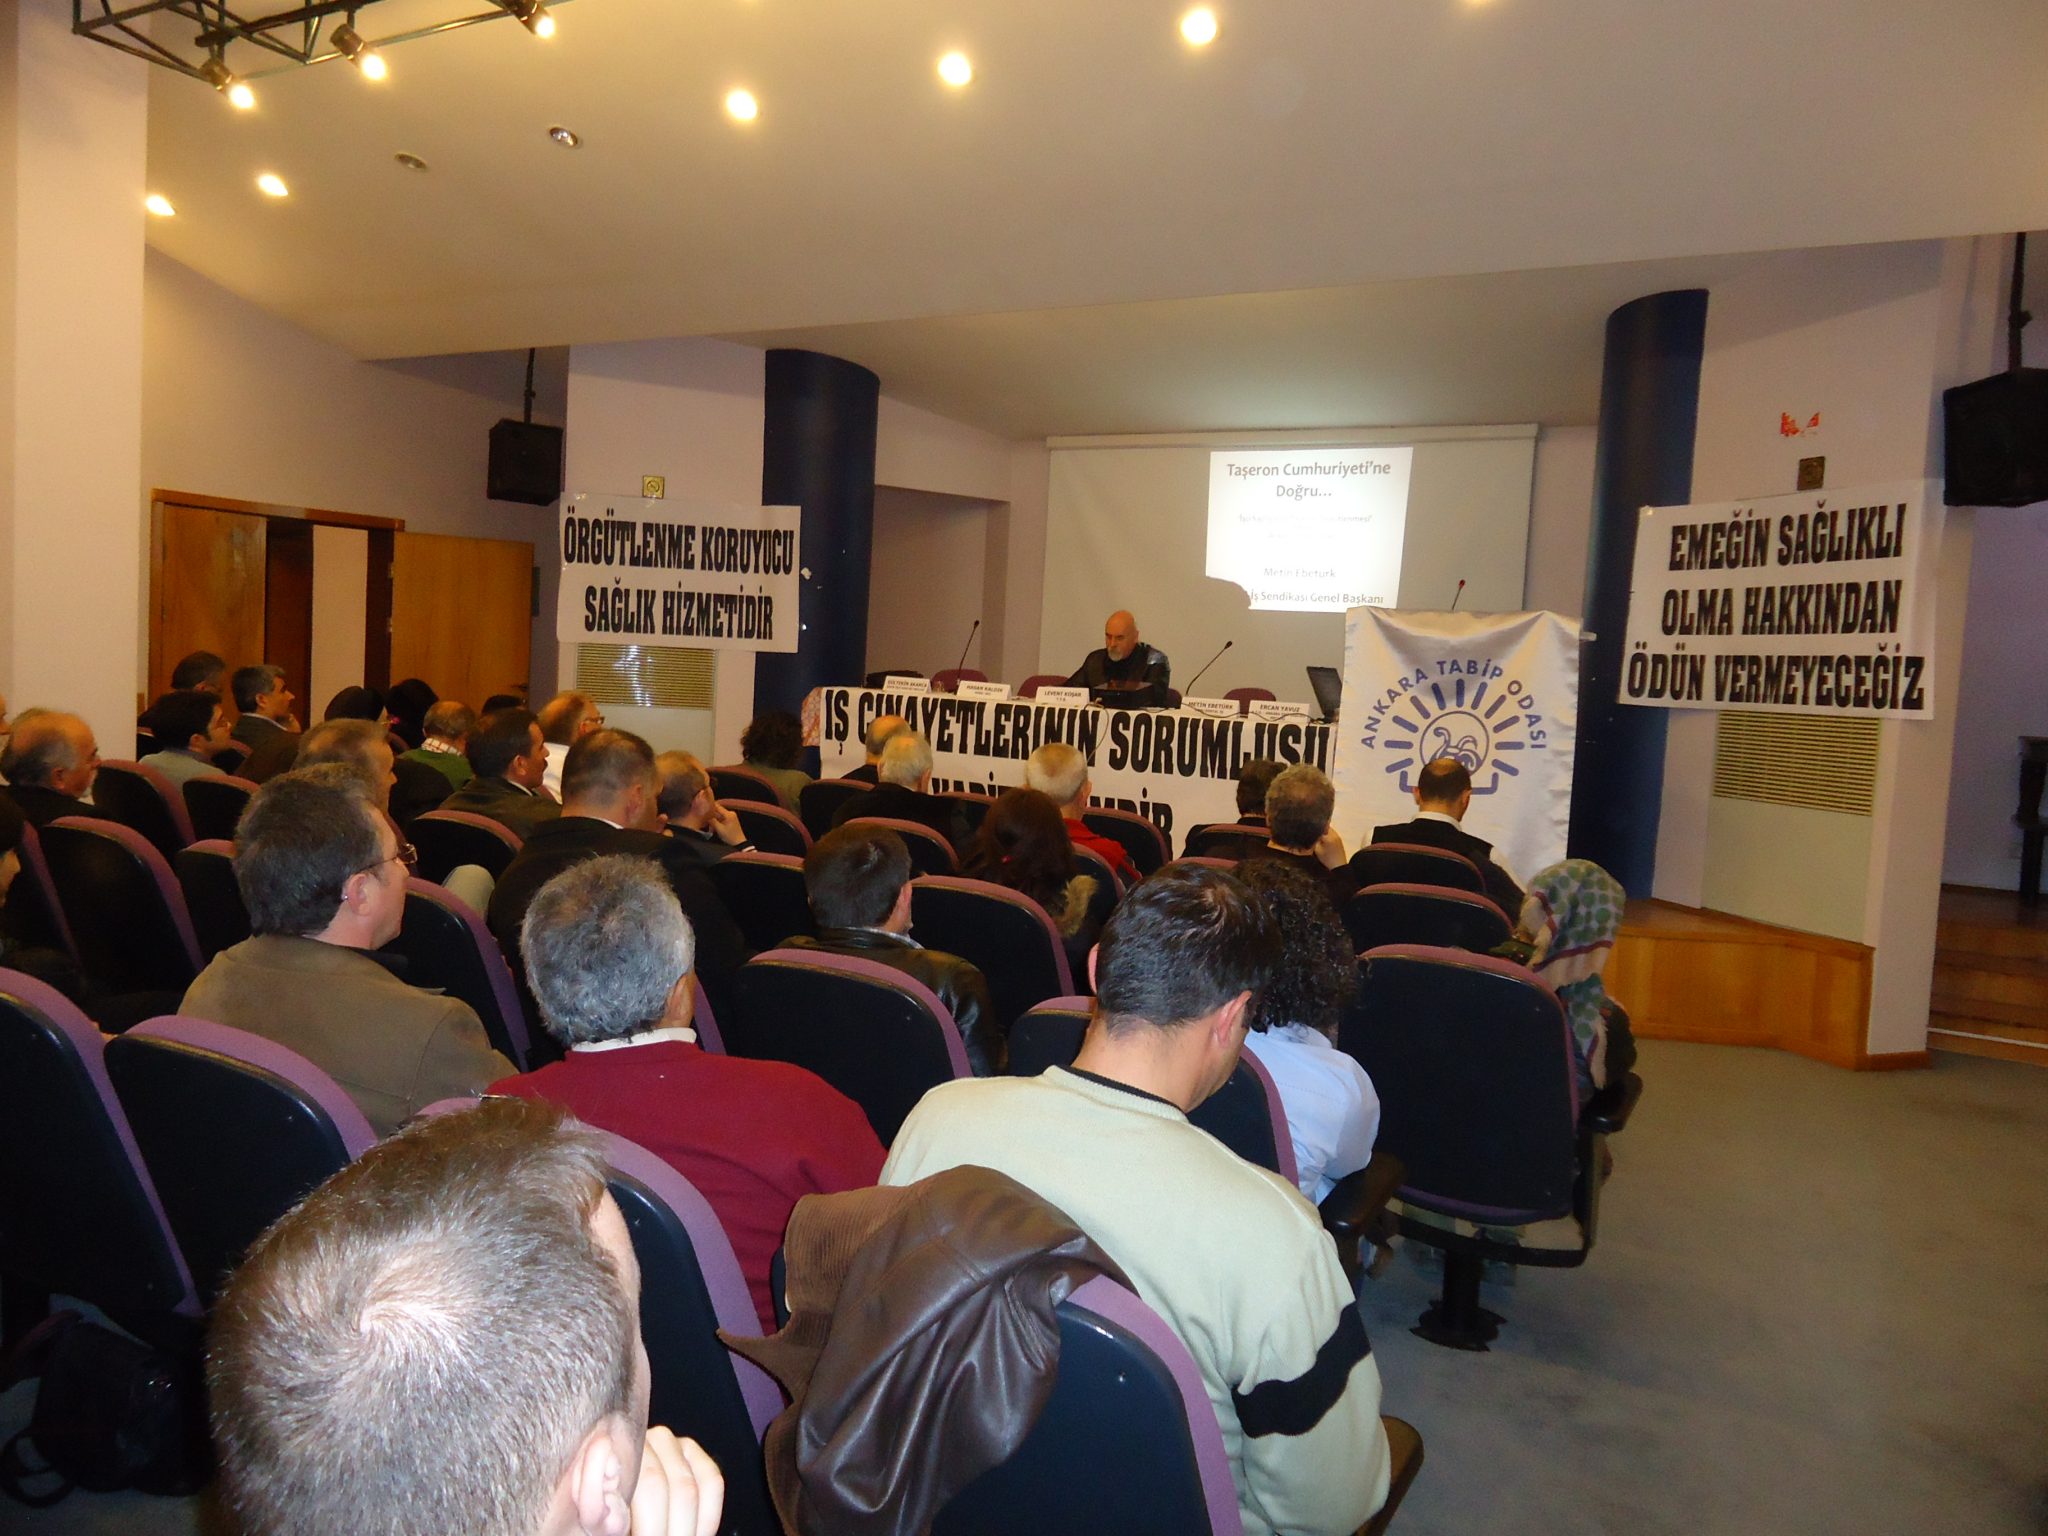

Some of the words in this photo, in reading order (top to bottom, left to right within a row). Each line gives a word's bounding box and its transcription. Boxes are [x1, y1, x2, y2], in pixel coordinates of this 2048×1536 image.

[1227, 463, 1279, 479] Taşeron
[1283, 460, 1391, 479] Cumhuriyeti'ne
[1276, 484, 1332, 501] Doğru...
[564, 505, 695, 570] ÖRGÜTLENME
[701, 525, 794, 575] KORUYUCU
[1669, 508, 1771, 571] EMEĞİN
[1777, 499, 1907, 566] SAĞLIKLI
[585, 576, 656, 634] SAĞLIK
[662, 580, 773, 640] HİZMETİDİR
[1310, 592, 1340, 603] Genel
[1662, 588, 1733, 635] OLMA
[1742, 579, 1903, 635] HAKKINDAN
[1361, 668, 1428, 749] ANKARA
[1437, 659, 1503, 680] TABİP
[1507, 680, 1547, 749] ODASI
[1627, 641, 1706, 700] ÖDÜN
[1715, 642, 1925, 710] VERMEYECEĞİZ
